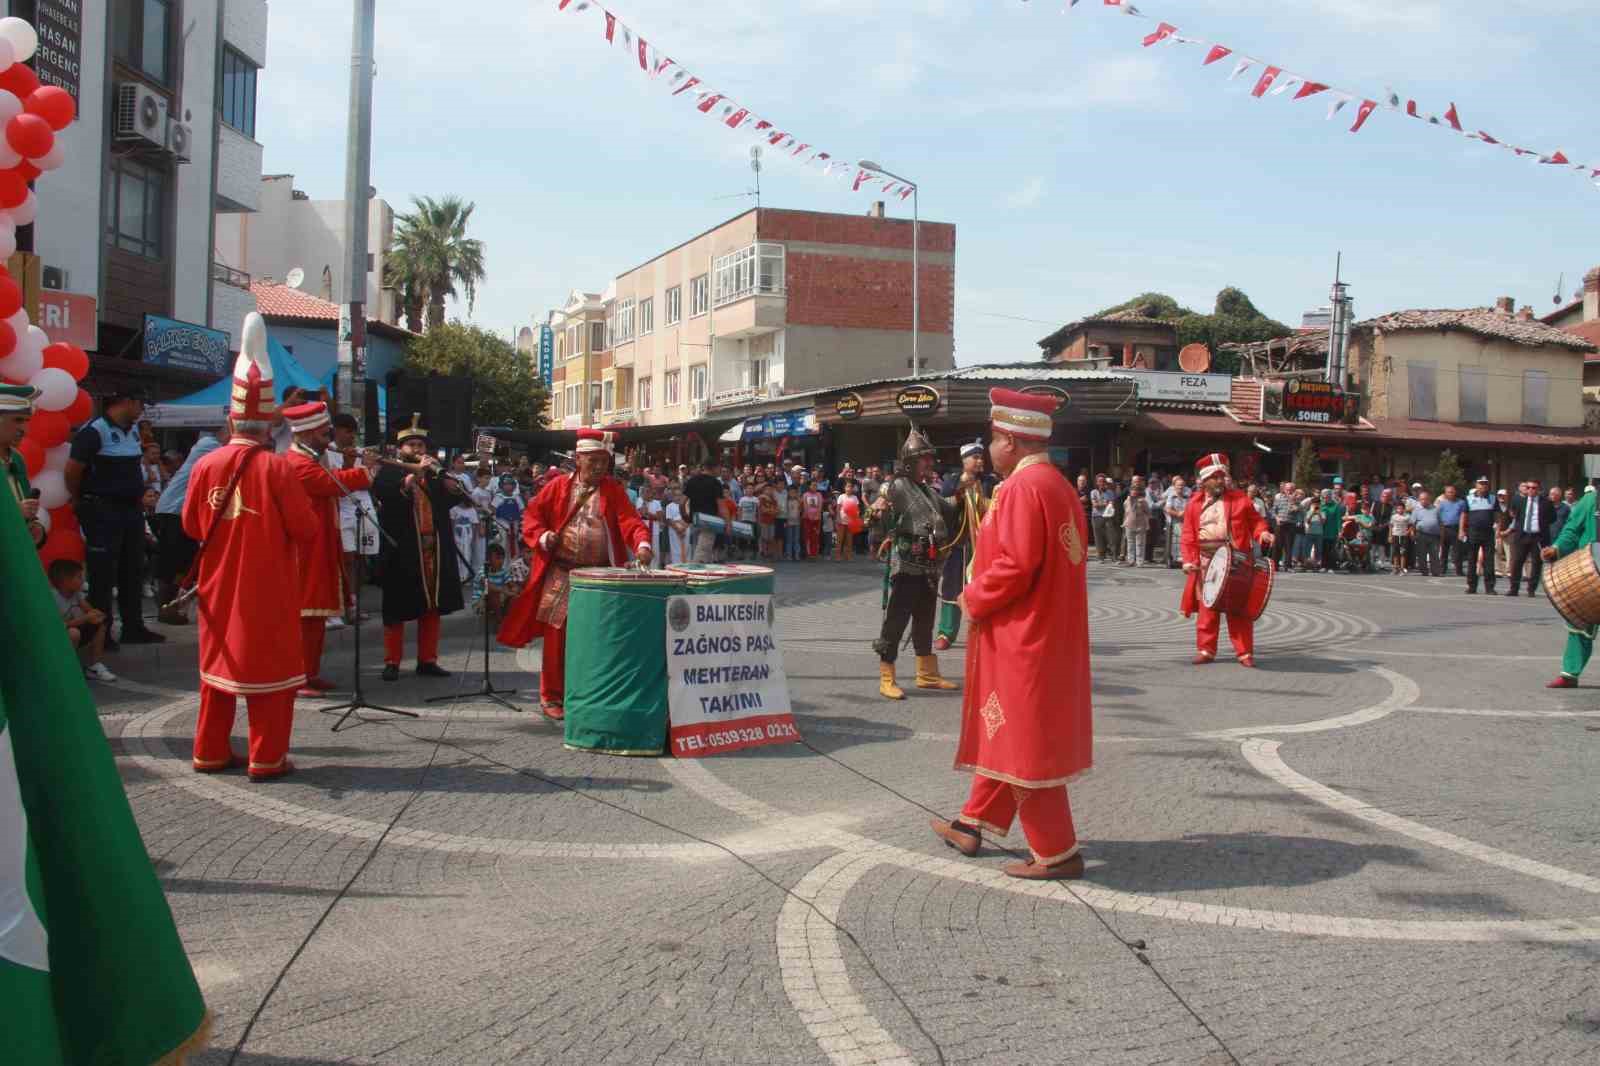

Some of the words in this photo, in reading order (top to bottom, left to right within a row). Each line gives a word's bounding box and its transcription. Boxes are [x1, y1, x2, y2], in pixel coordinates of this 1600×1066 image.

[39, 22, 76, 55] HASAN
[1180, 377, 1208, 387] FEZA
[1298, 411, 1329, 422] SONER
[696, 601, 765, 623] BALIKESİR
[673, 634, 741, 656] ZAĞNOS
[683, 663, 770, 686] MEHTERAN
[699, 692, 763, 714] TAKIMI
